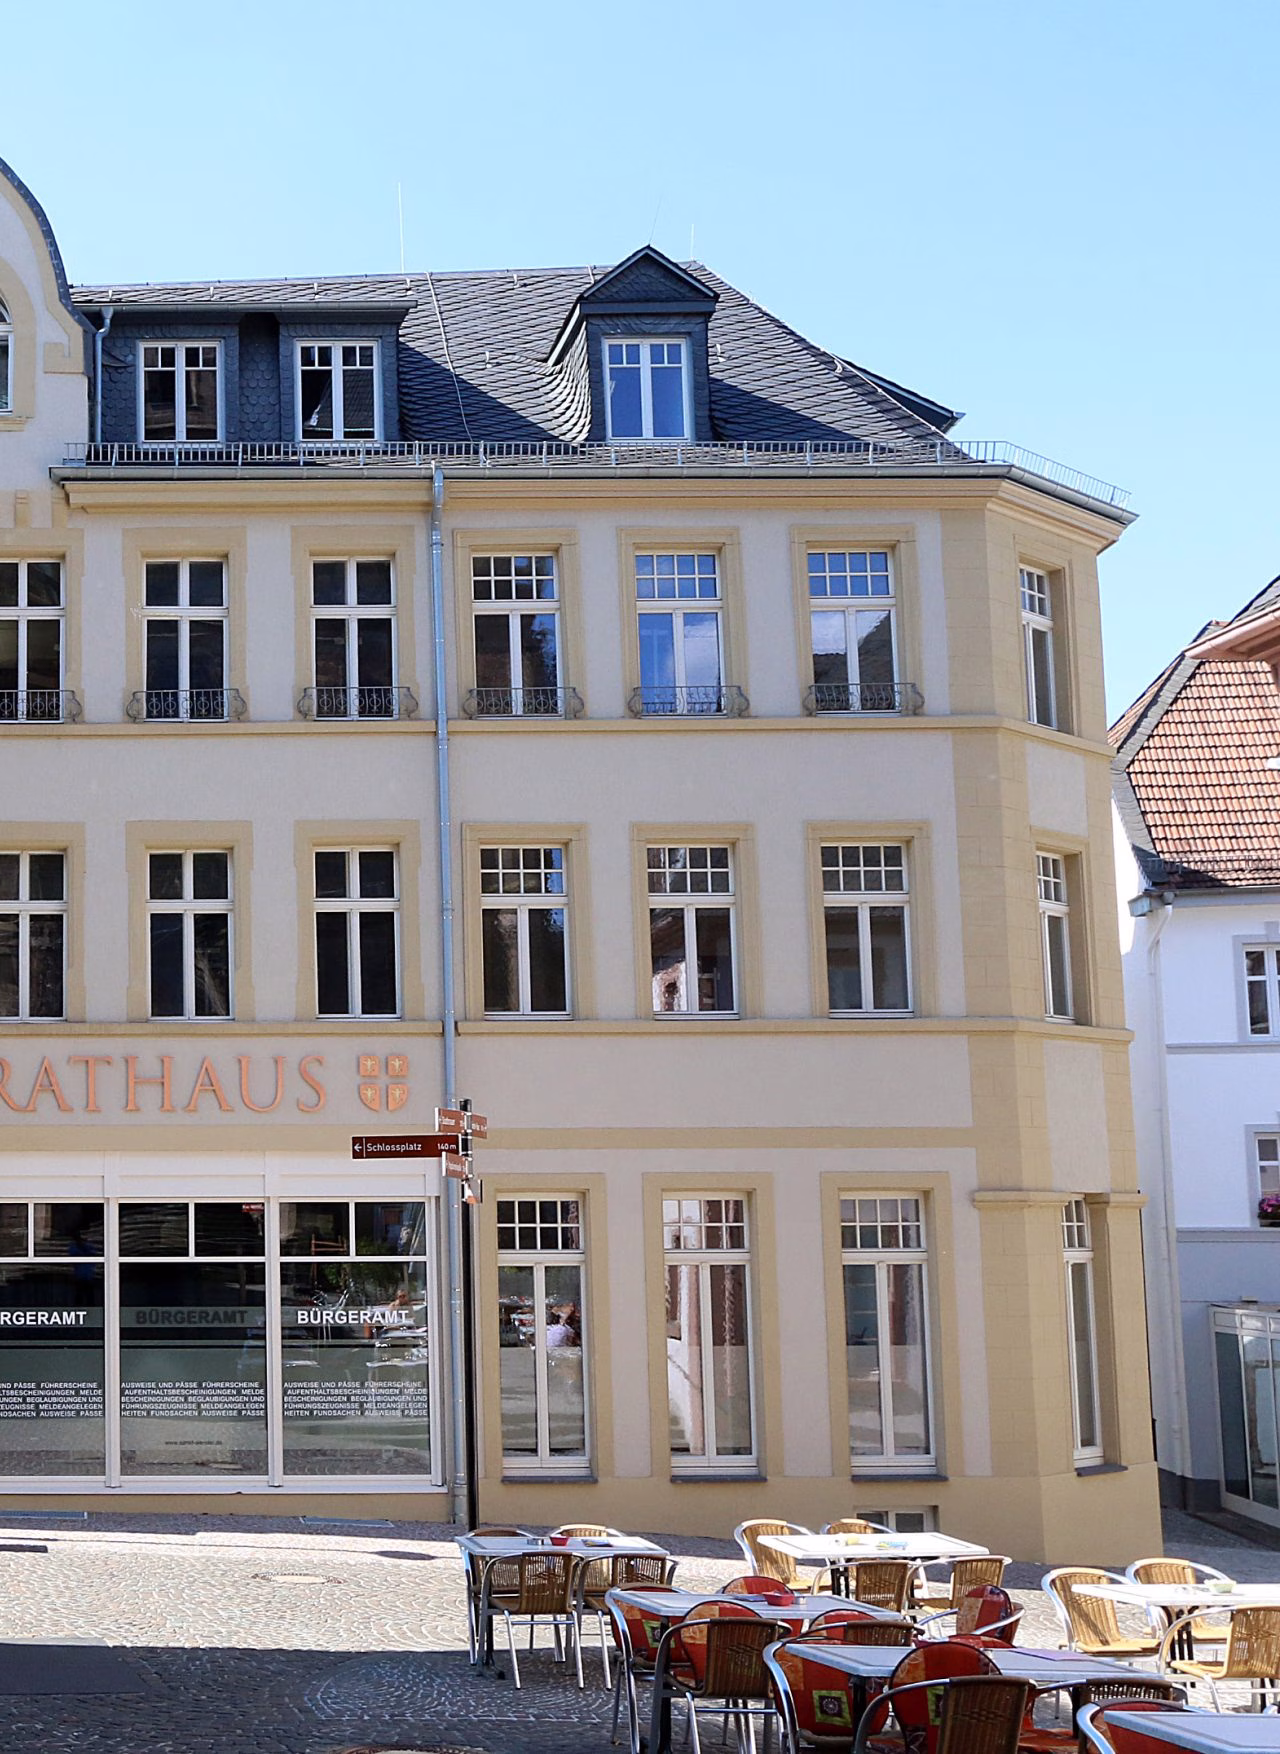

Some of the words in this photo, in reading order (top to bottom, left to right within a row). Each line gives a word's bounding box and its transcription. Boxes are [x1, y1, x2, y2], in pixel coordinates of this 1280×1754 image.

[366, 1143, 422, 1152] Schlossplatz
[437, 1143, 449, 1151] 140
[135, 1309, 248, 1325] BÜRGERAMT
[297, 1308, 409, 1325] BÜRGERAMT
